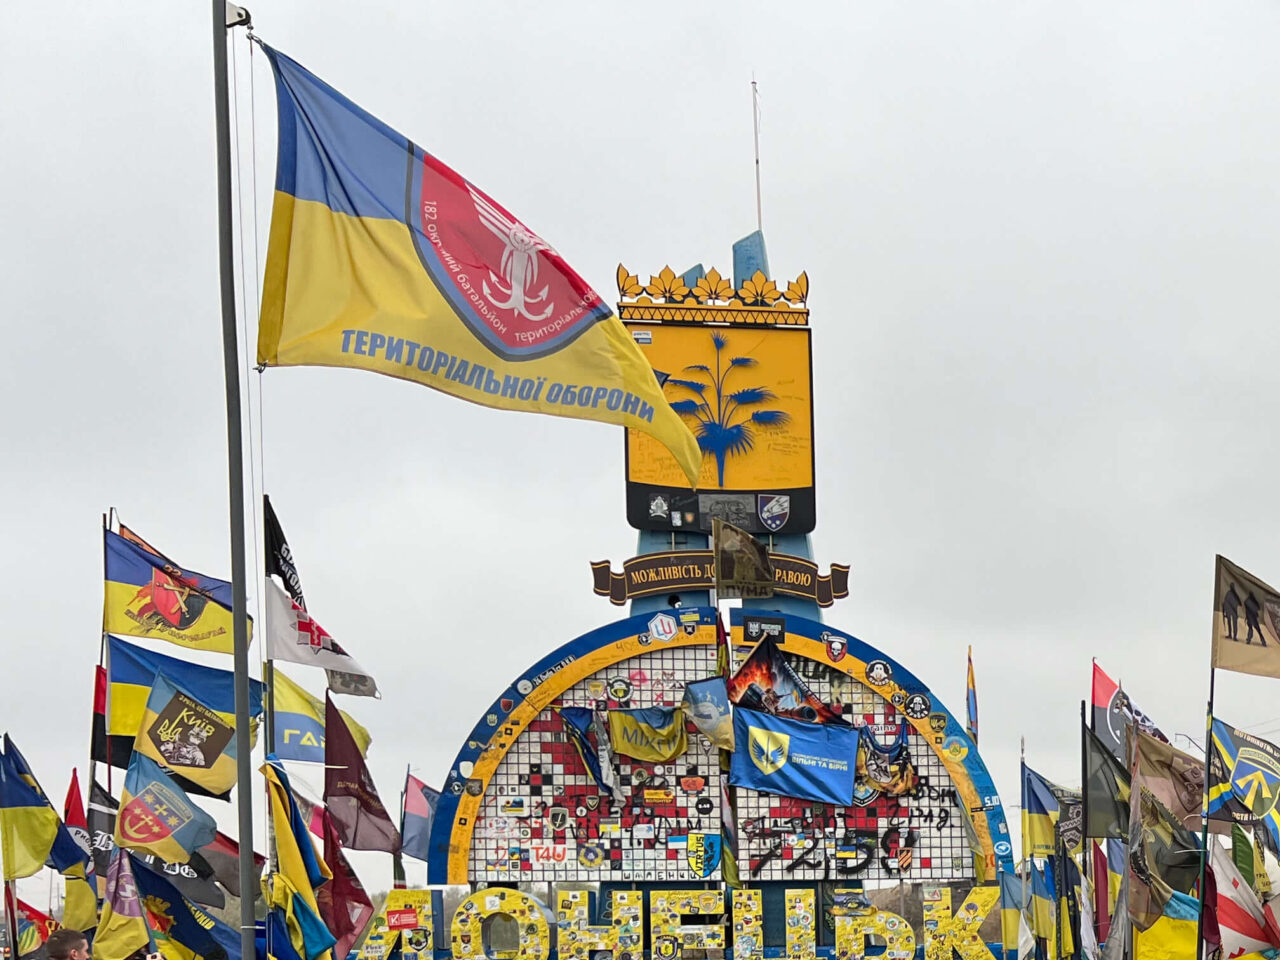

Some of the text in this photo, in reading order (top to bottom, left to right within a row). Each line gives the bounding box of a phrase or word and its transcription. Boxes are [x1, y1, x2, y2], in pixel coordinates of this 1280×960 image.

[424, 201, 437, 222] 182
[341, 329, 654, 424] ТЕРИТОРІАЛЬНОЇ ОБОРОНИ
[631, 564, 702, 585] МОЖЛИВІСТЬ
[775, 570, 812, 587] РАВОЮ
[181, 707, 215, 737] Київ
[870, 723, 896, 733] raine
[695, 835, 705, 872] VIRTUS
